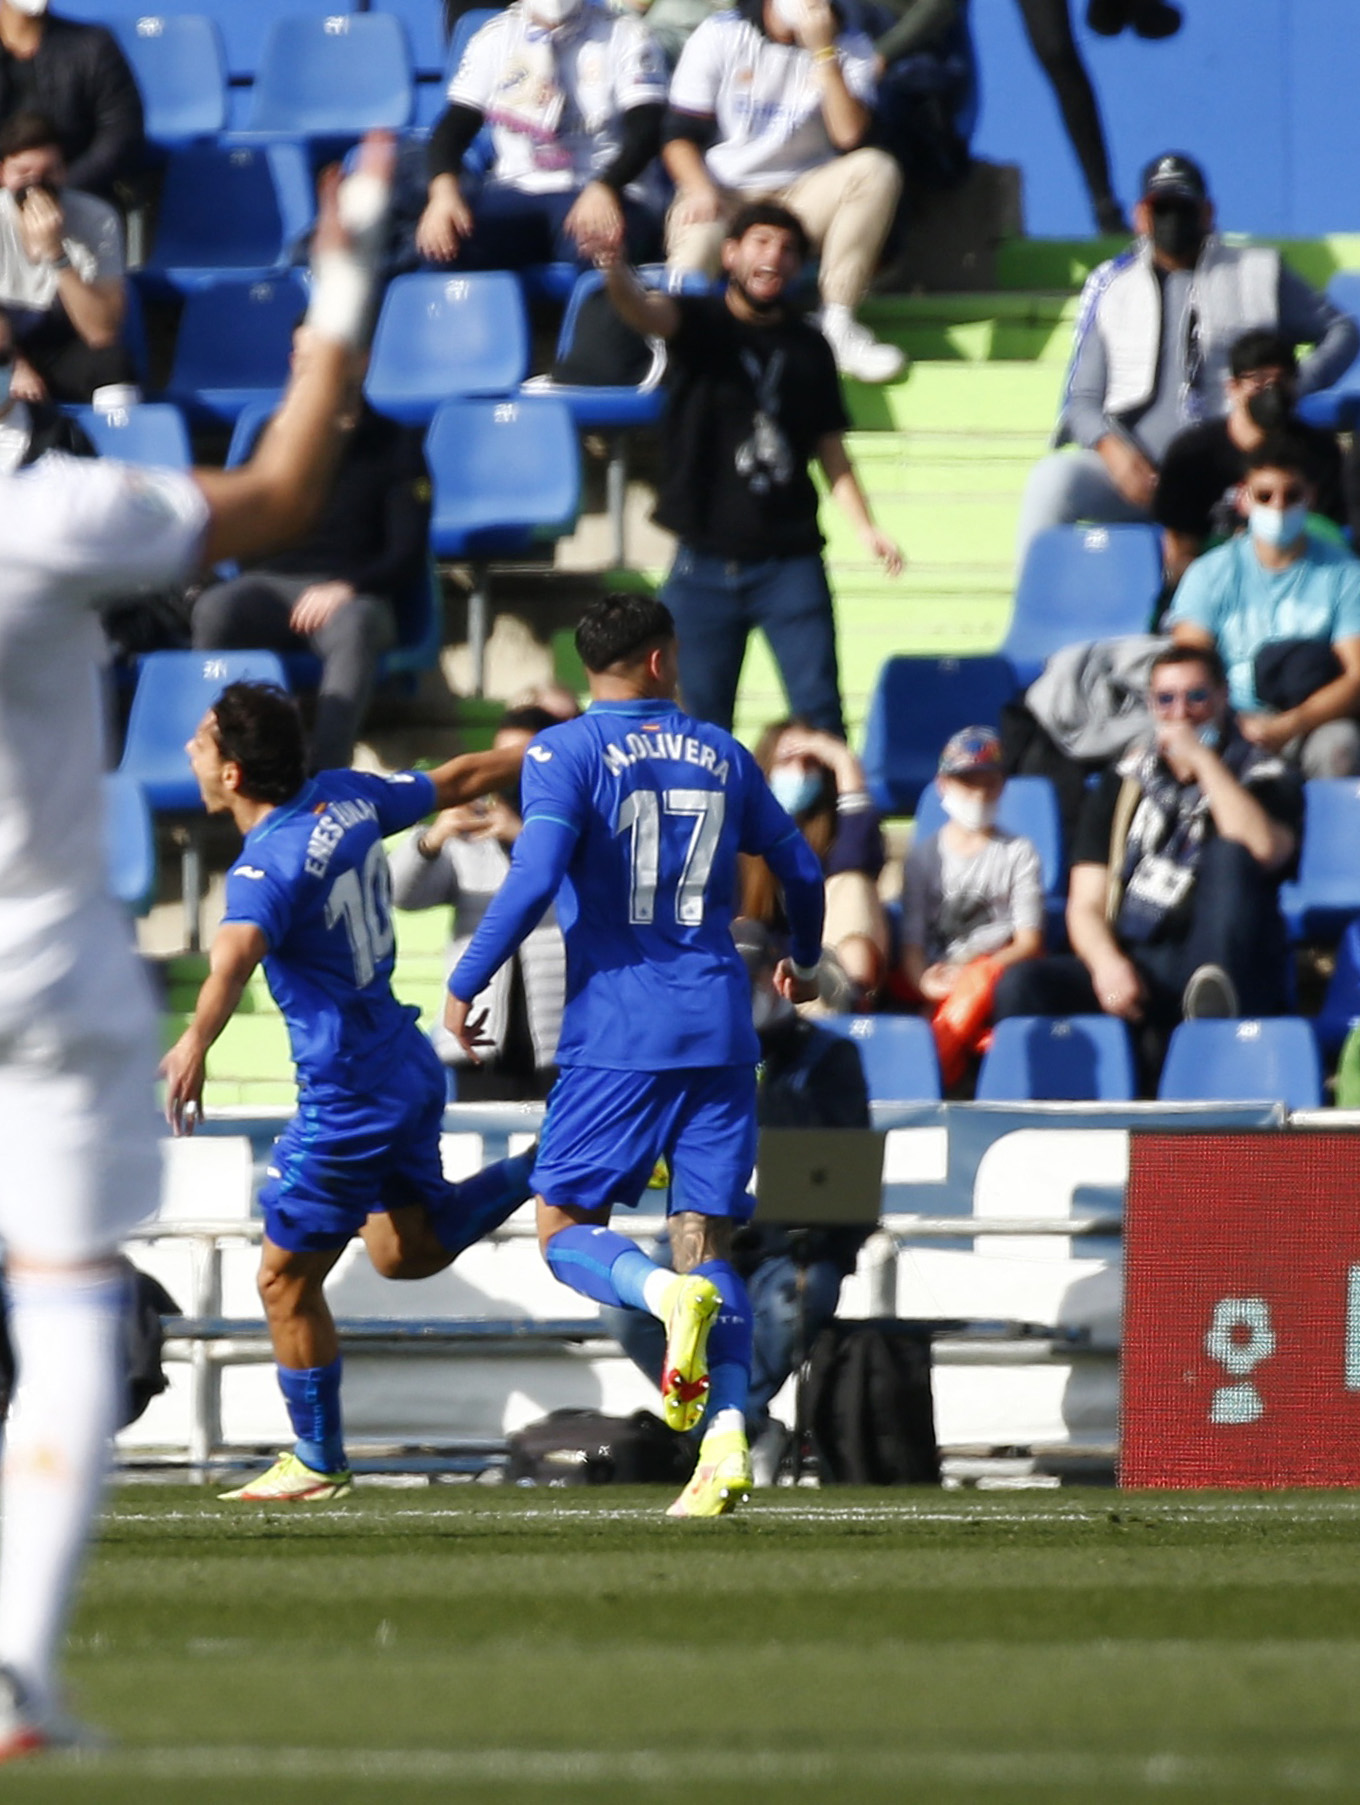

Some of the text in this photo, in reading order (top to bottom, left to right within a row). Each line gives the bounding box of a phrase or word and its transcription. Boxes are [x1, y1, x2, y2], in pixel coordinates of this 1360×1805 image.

[304, 815, 345, 879] ENES
[324, 839, 394, 990] 10
[616, 788, 726, 926] 17
